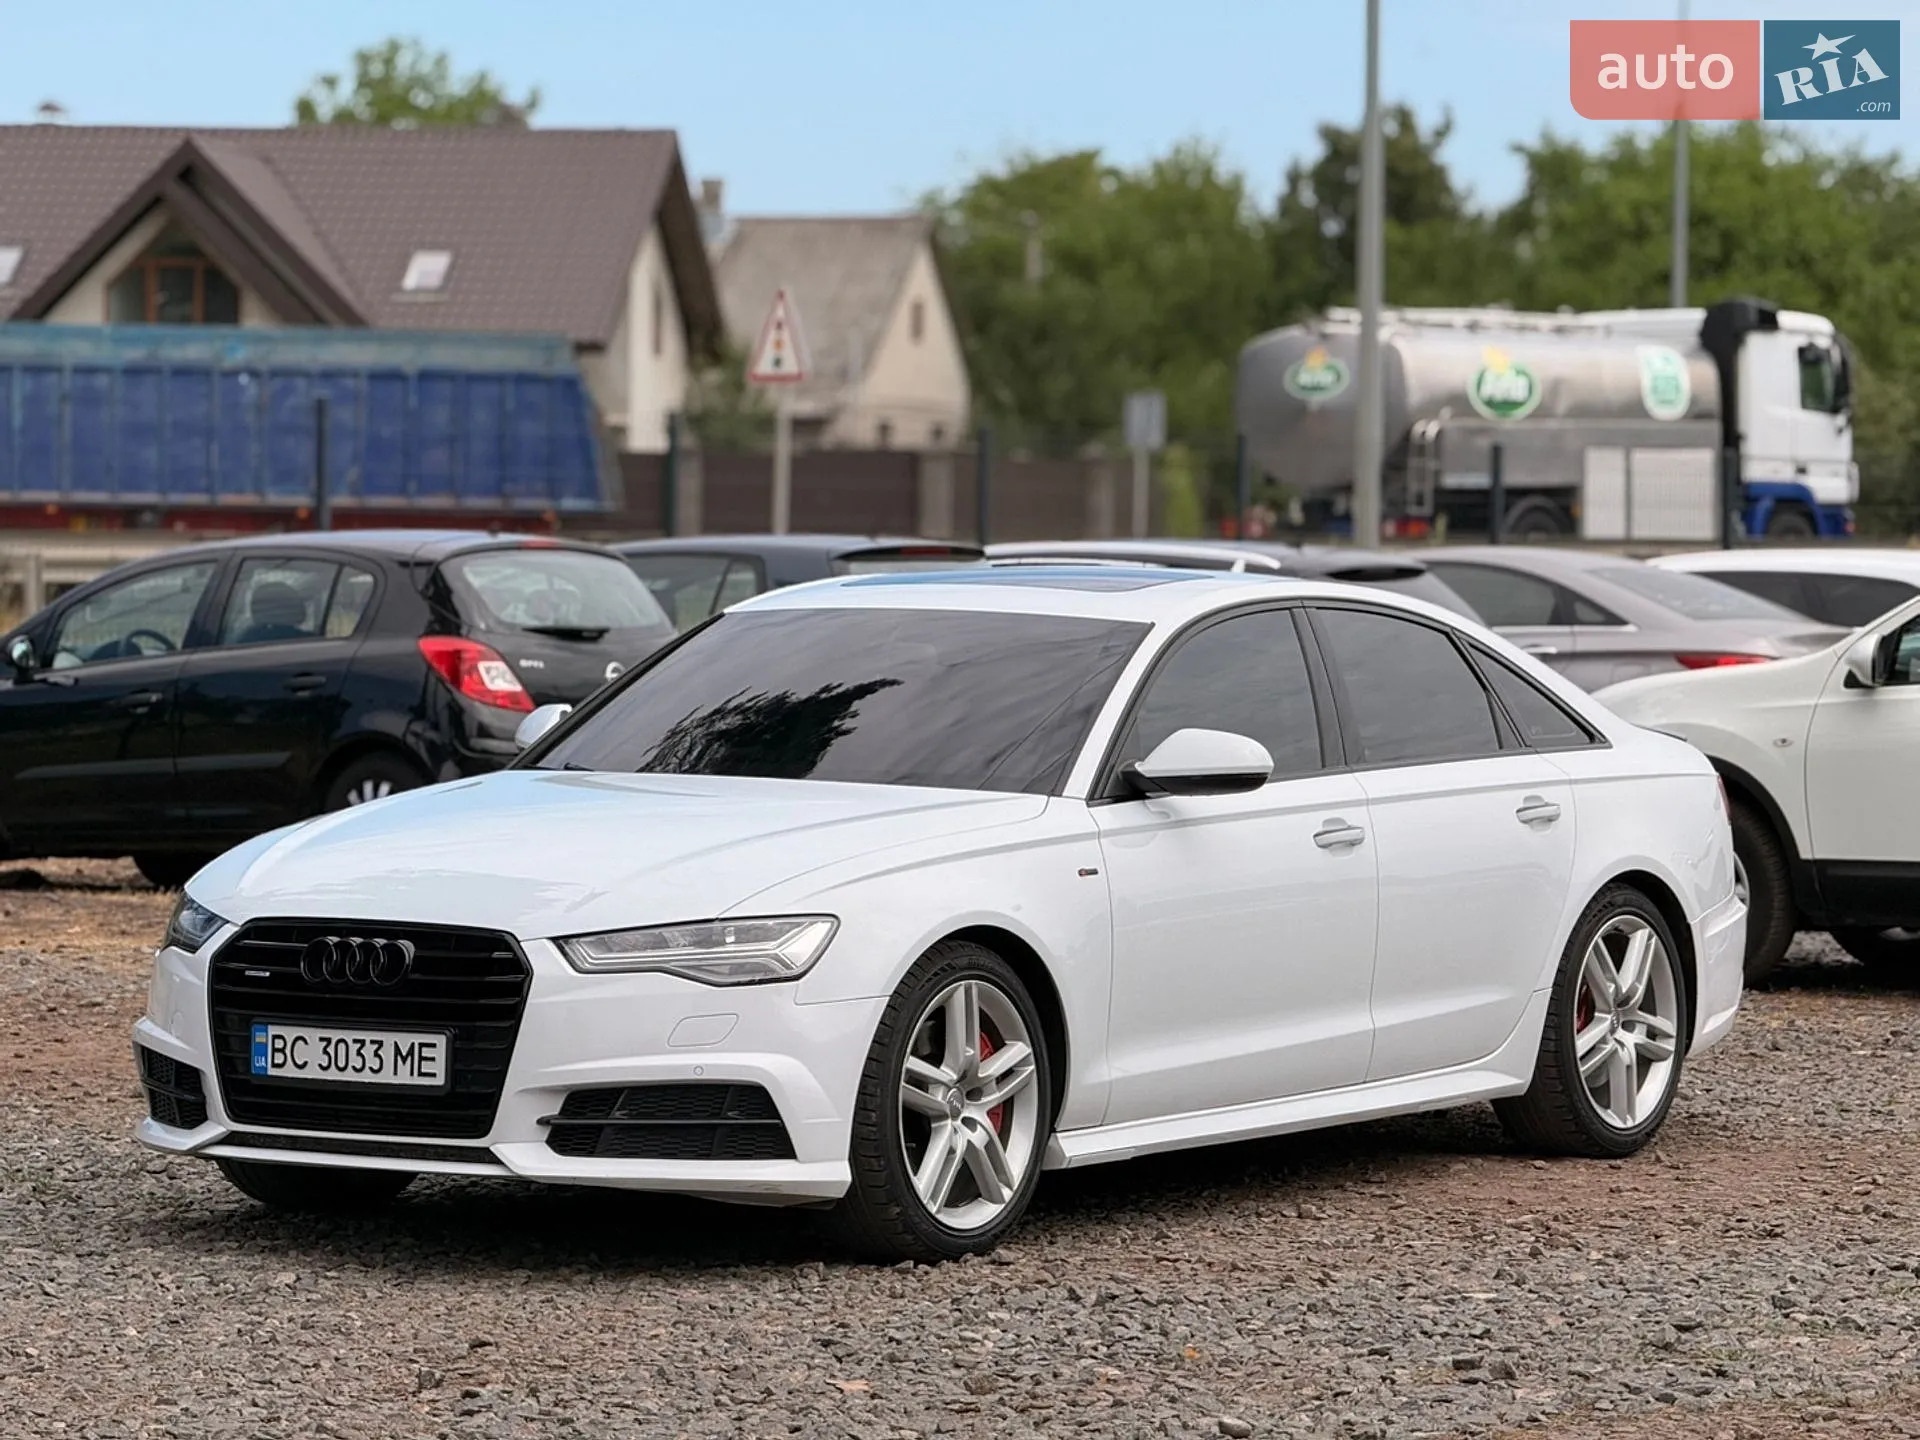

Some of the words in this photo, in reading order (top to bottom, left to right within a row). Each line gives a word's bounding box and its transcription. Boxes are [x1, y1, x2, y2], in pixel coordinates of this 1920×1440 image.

[254, 1055, 267, 1067] UA
[270, 1034, 309, 1070] BC
[317, 1036, 384, 1074] 3033
[393, 1040, 437, 1078] ME
